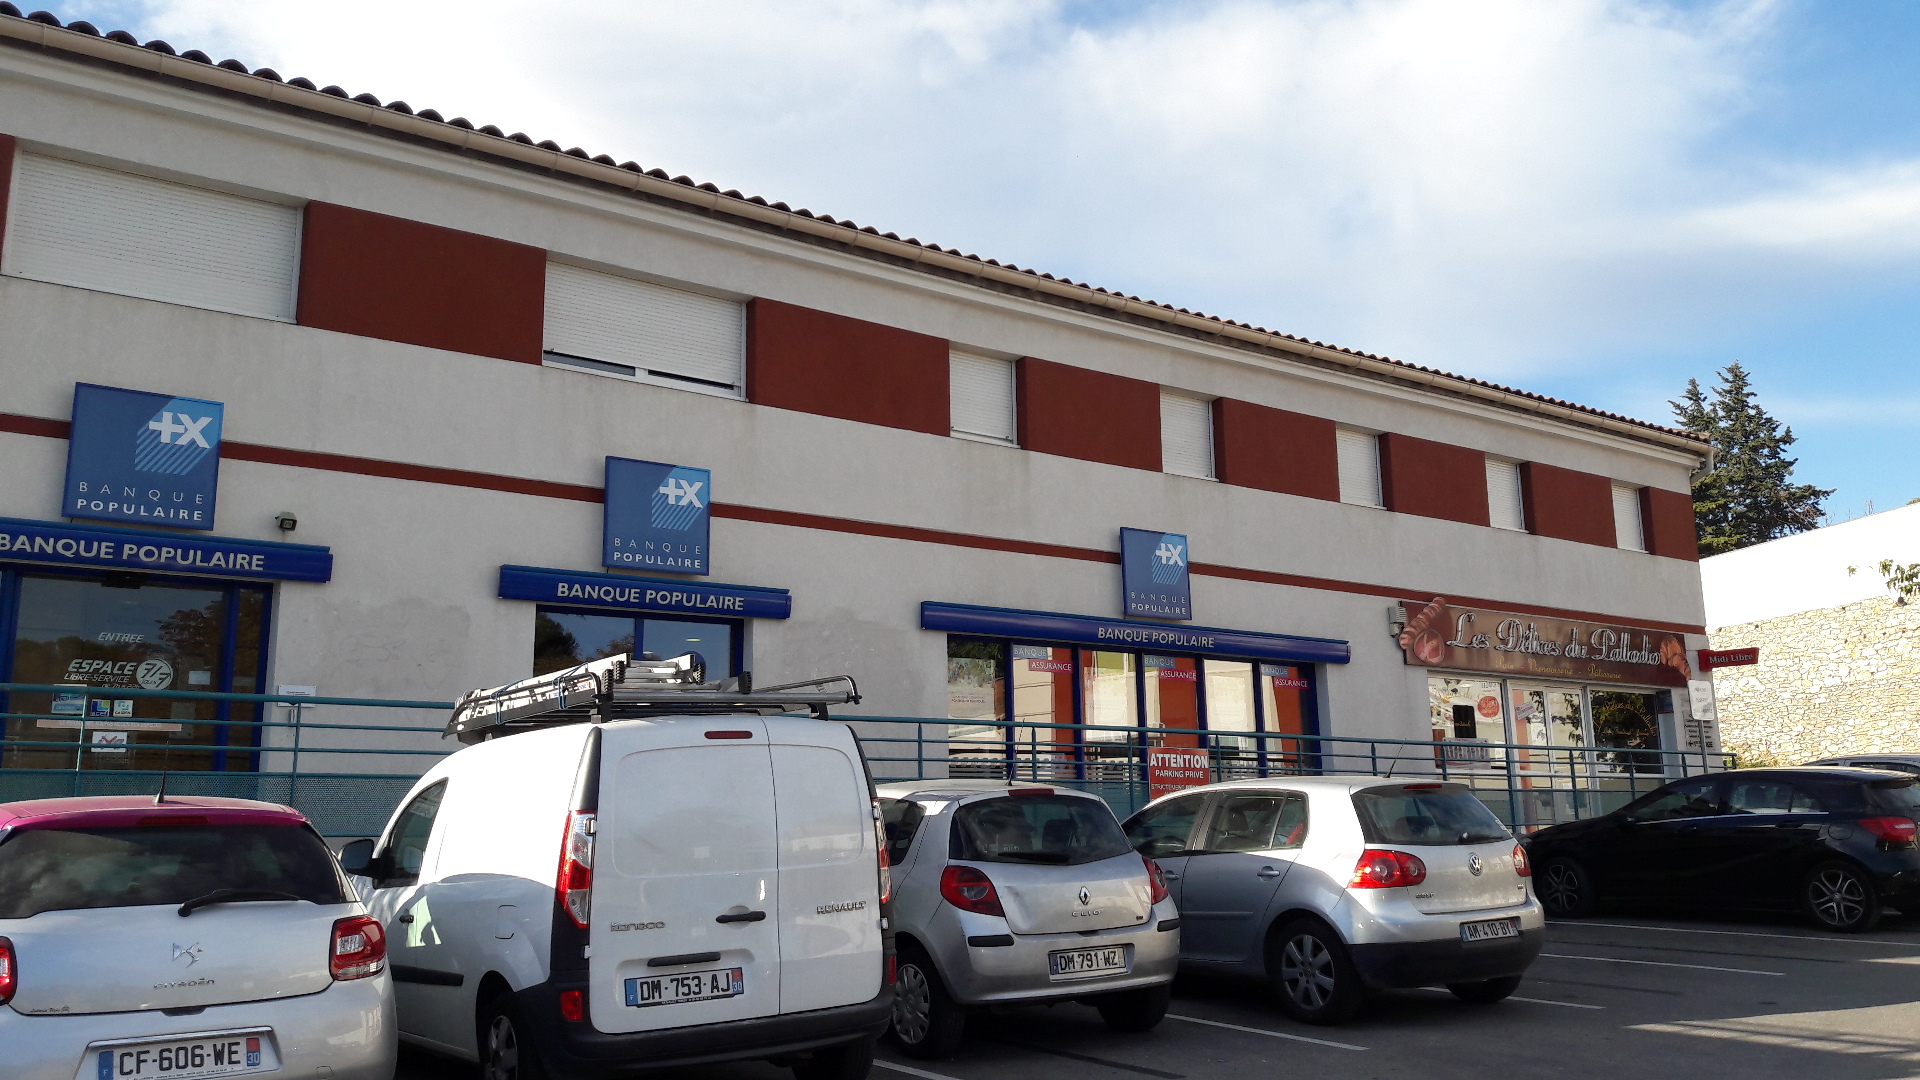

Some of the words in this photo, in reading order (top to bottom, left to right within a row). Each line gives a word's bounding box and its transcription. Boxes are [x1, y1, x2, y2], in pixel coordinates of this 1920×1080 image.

[79, 481, 203, 505] BANQUE
[77, 499, 203, 521] POPULAIRE
[0, 534, 115, 559] BANQUE
[122, 543, 265, 571] POPULAIRE
[614, 537, 701, 555] BANQUE
[613, 552, 701, 569] POPULAIRE
[557, 583, 640, 603] BANQUE
[646, 589, 745, 611] POPULAIRE
[1131, 592, 1186, 604] BANQUE
[1131, 603, 1187, 614] POPULAIRE
[98, 632, 144, 642] ENTREE
[1098, 628, 1149, 643] BANQUE
[1152, 631, 1215, 648] POPULAIRE
[1447, 612, 1491, 648] Les
[1494, 618, 1562, 656] Délices
[1565, 627, 1589, 658] du
[1591, 628, 1661, 665] Palladio
[1014, 647, 1047, 657] BANQUE
[1709, 654, 1728, 664] Midi
[1731, 653, 1754, 662] Libre
[68, 659, 137, 674] ESPACE
[1031, 662, 1072, 671] ASSURANCE
[1145, 657, 1174, 666] BANQUE
[1496, 656, 1514, 670] Pain
[64, 673, 130, 682] LIBRE-SERVICE
[1160, 670, 1197, 680] ASSURANCE
[1261, 667, 1288, 675] BANQUE
[1275, 679, 1308, 688] ASSURANCE
[1150, 753, 1209, 768] ATTENTION
[1156, 770, 1184, 778] PARKING
[1185, 771, 1204, 779] PRIVE
[816, 900, 867, 915] RENAULT
[1467, 921, 1511, 939] AM-410-BY
[1059, 950, 1118, 971] DM-791-WZ
[640, 972, 731, 1001] DM-753-AJ
[733, 982, 742, 992] 30
[119, 1041, 241, 1076] CF-606-WE
[246, 1053, 260, 1064] 30
